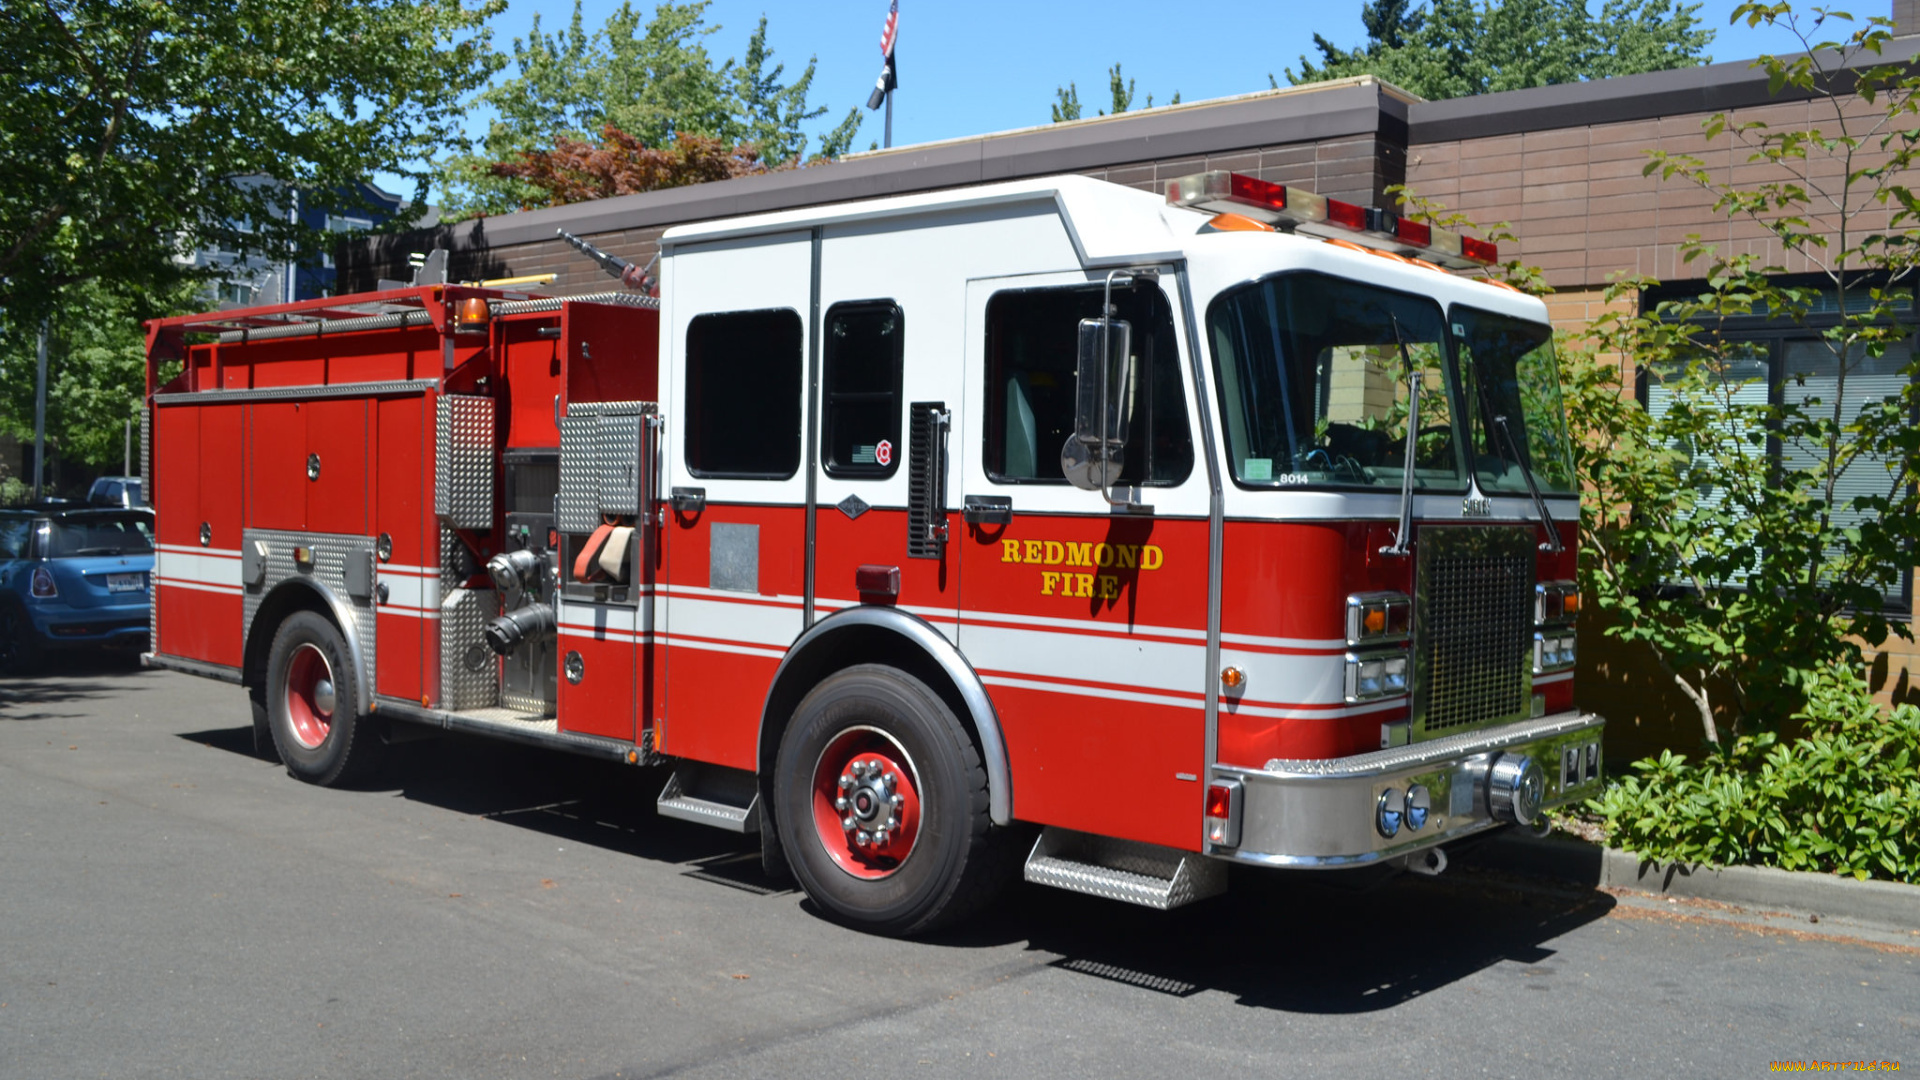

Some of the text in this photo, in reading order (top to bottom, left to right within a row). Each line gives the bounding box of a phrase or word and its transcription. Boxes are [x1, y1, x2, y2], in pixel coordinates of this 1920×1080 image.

[1280, 473, 1309, 484] 8014
[1001, 539, 1164, 570] REDMOND
[1041, 571, 1118, 599] FIRE
